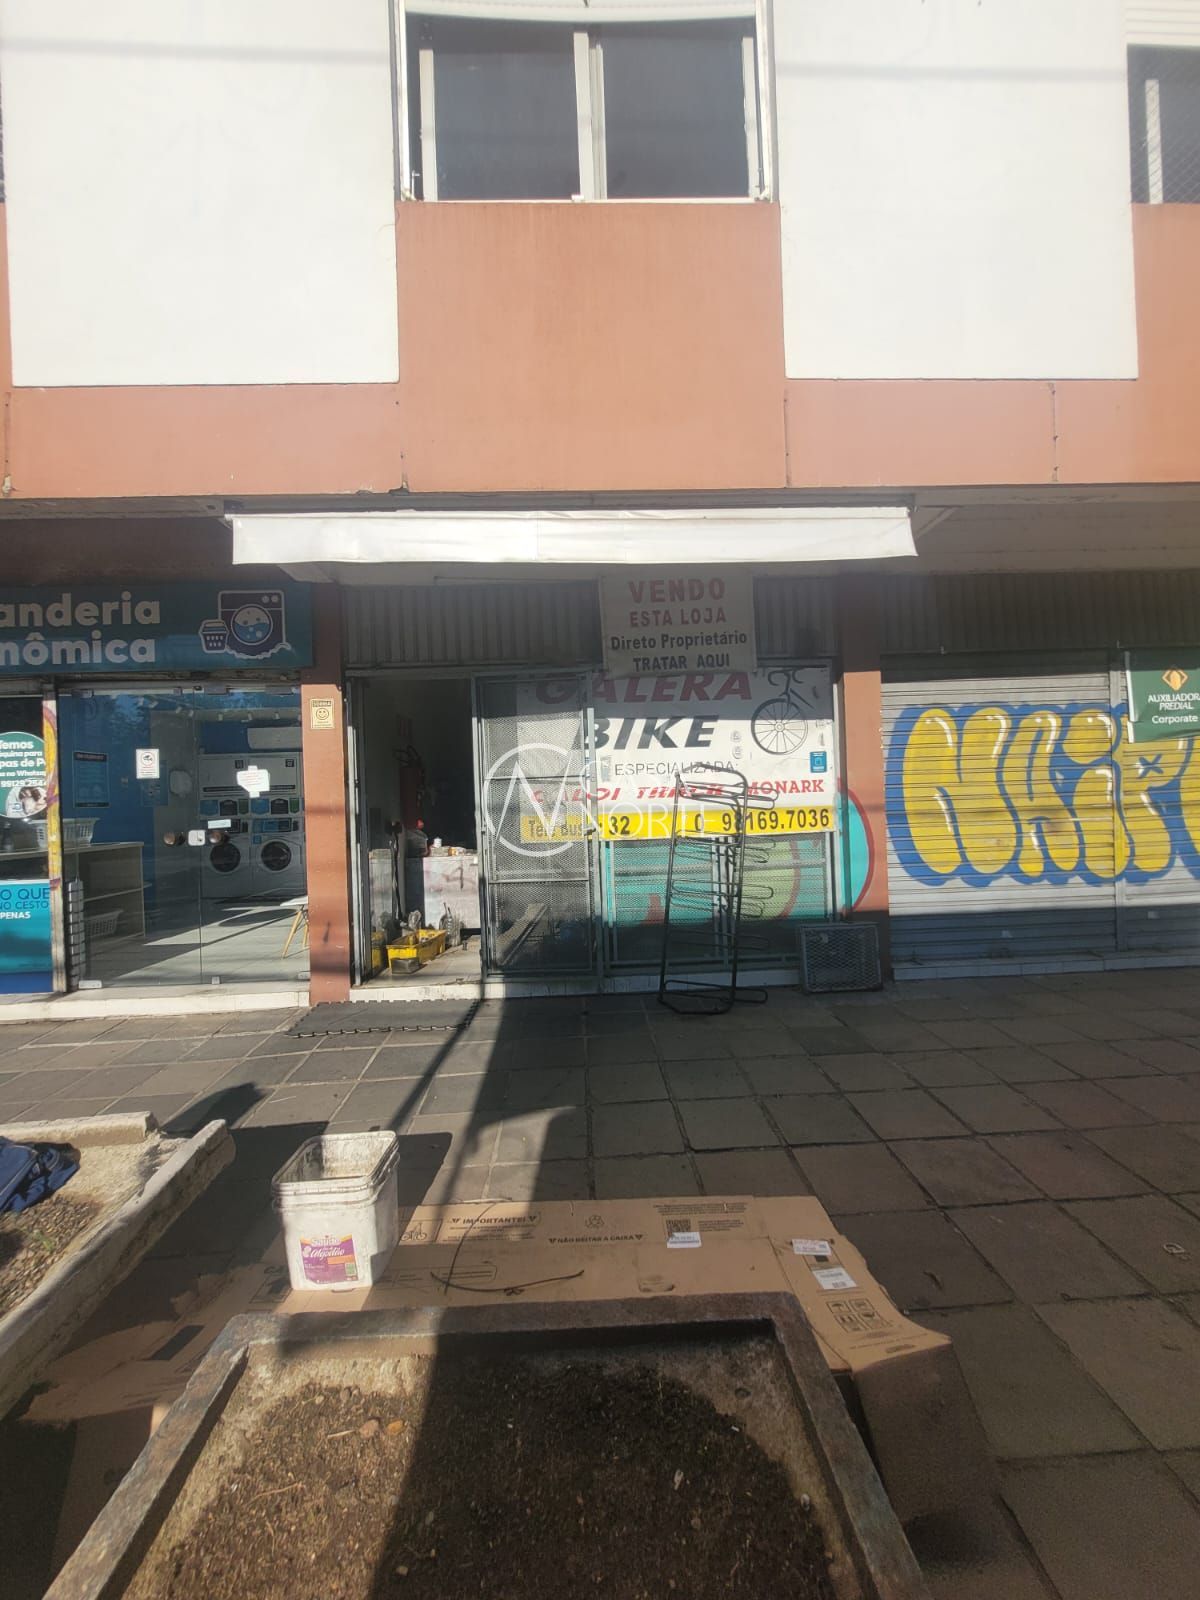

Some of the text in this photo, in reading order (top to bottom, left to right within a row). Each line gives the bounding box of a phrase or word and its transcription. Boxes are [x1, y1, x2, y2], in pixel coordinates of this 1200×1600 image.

[628, 577, 725, 603] VENDO
[630, 607, 727, 628] ESTA LOJA
[0, 630, 155, 665] nômica
[611, 630, 747, 650] Direto Proprietário
[633, 653, 730, 672] TRATAR AQUI
[1159, 702, 1193, 711] PREDIAL
[1151, 715, 1198, 725] Corporate
[571, 715, 719, 750] BIKE
[18, 887, 50, 900] QUE
[15, 900, 49, 909] CESTO
